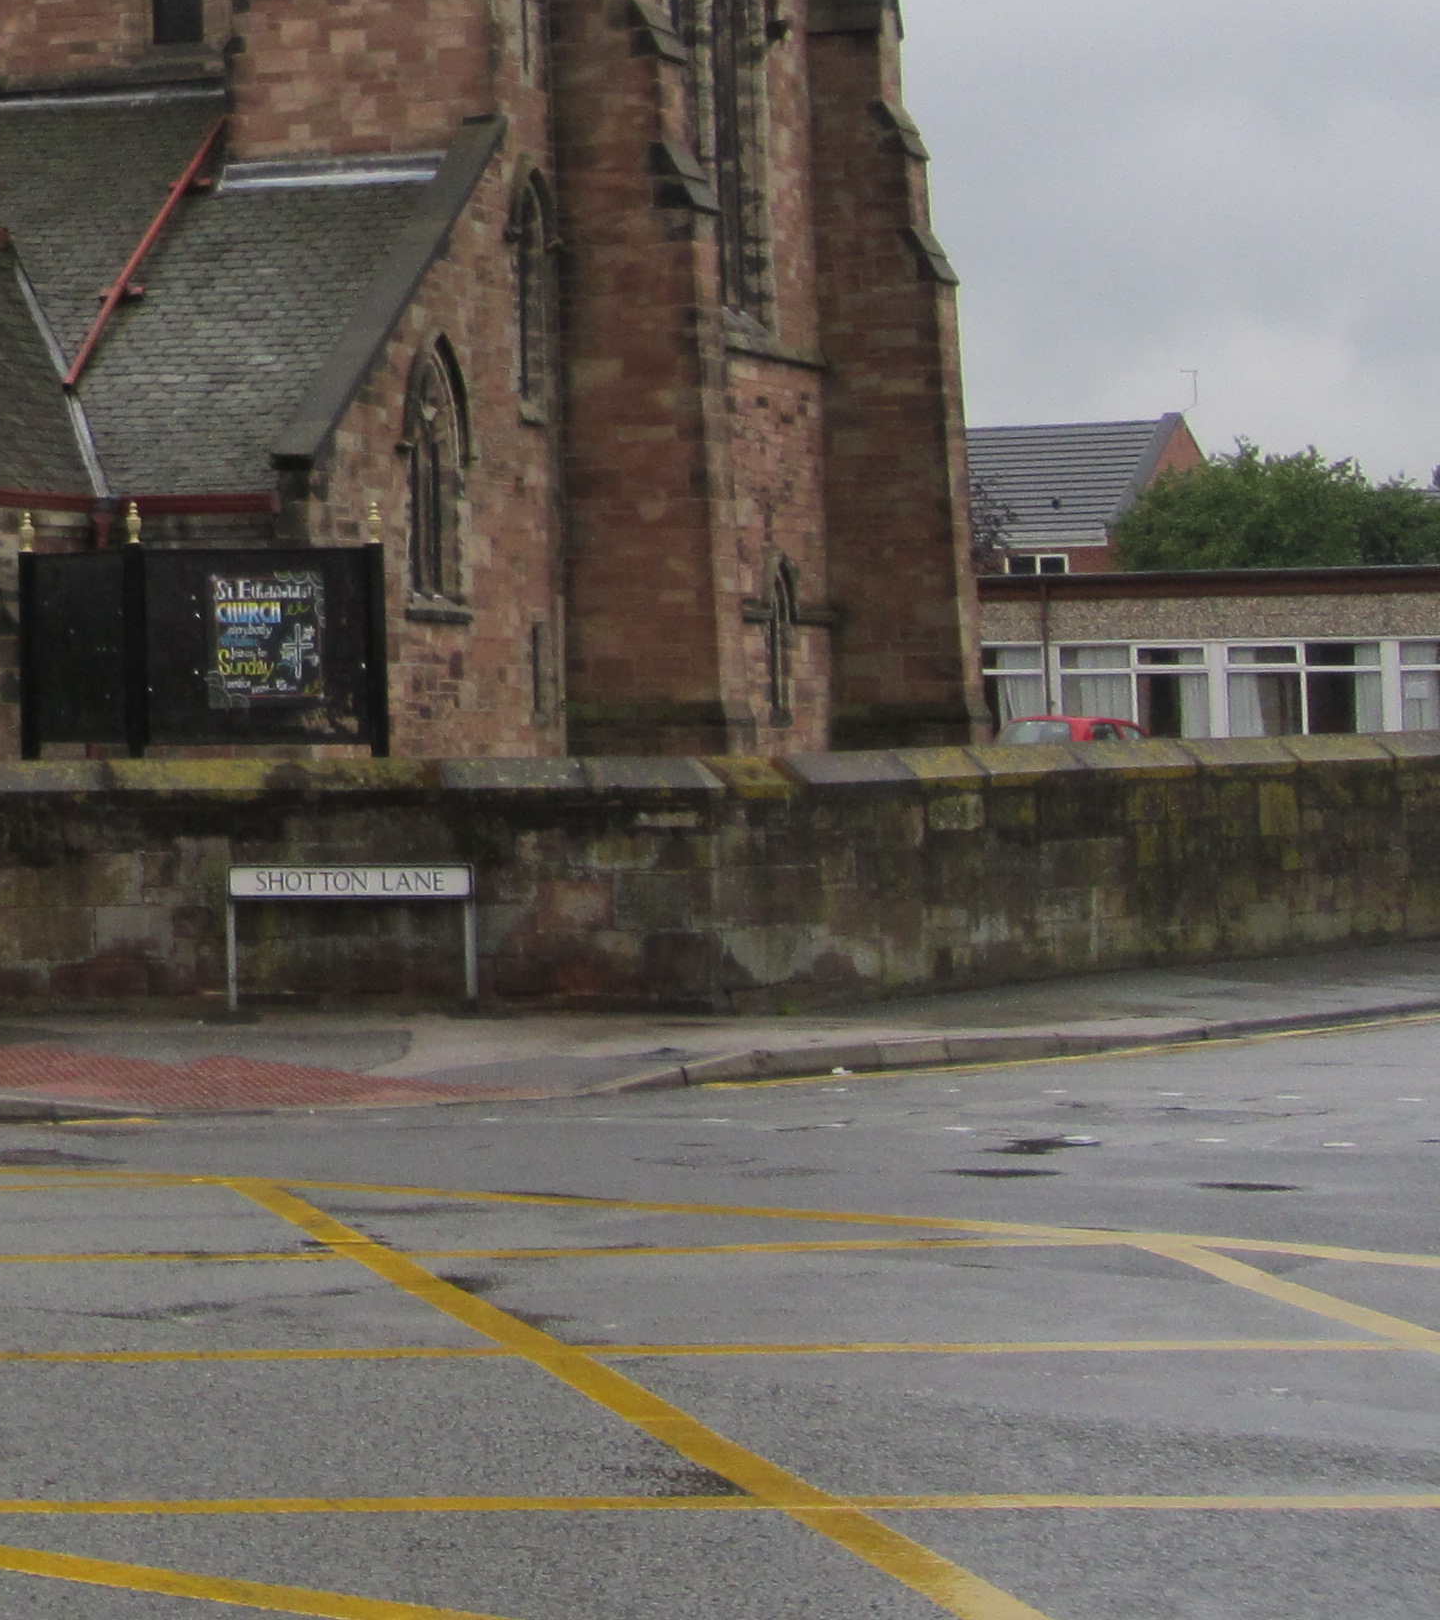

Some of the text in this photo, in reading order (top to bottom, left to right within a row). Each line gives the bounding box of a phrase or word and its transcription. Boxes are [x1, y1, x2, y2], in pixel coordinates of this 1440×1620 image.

[215, 601, 282, 623] CHURCH
[218, 649, 275, 682] Sunday
[255, 871, 445, 892] SHOTTON LANE
